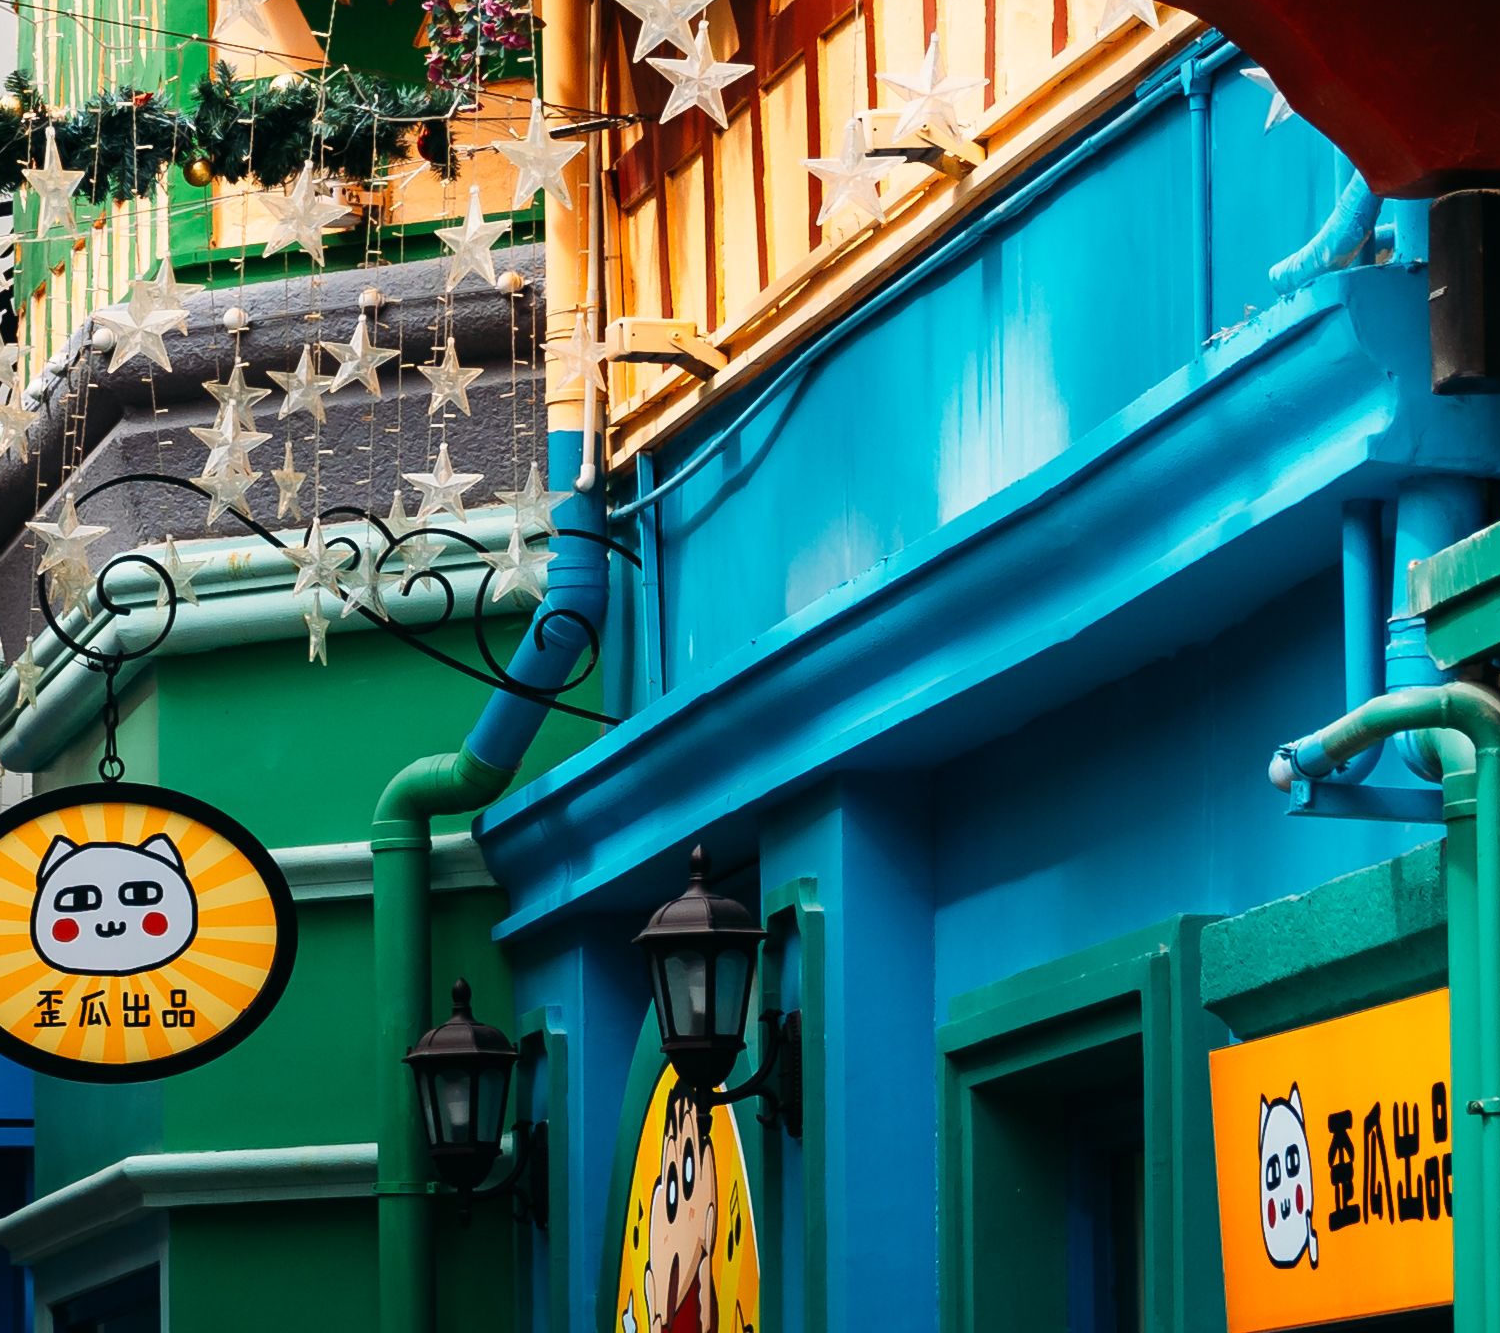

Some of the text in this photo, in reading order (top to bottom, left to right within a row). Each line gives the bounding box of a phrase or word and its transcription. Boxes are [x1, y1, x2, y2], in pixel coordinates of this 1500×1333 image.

[34, 989, 196, 1028] 歪瓜出品
[1328, 1081, 1453, 1232] 歪瓜出品
